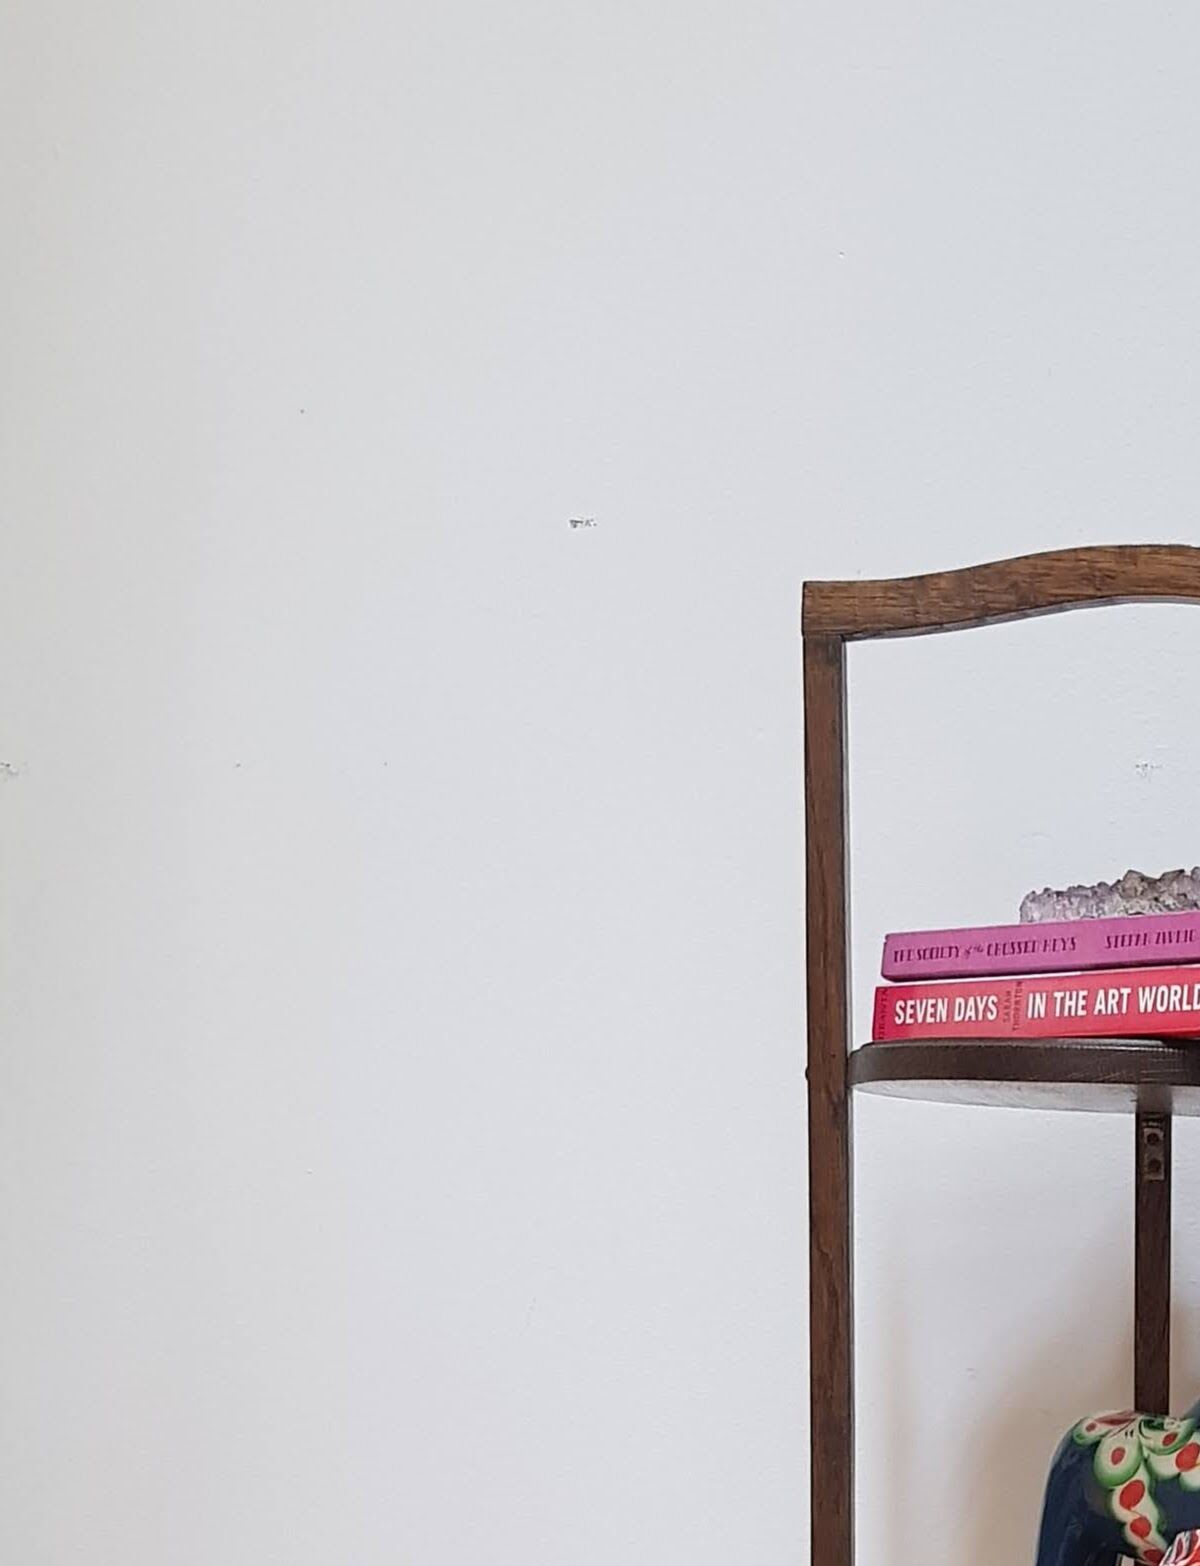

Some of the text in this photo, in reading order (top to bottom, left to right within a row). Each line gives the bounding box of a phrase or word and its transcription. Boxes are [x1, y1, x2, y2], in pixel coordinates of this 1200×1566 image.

[894, 995, 998, 1025] SEVEN DAYS
[1027, 992, 1047, 1019] IN
[1053, 990, 1088, 1017] THE
[1094, 988, 1131, 1016] ART
